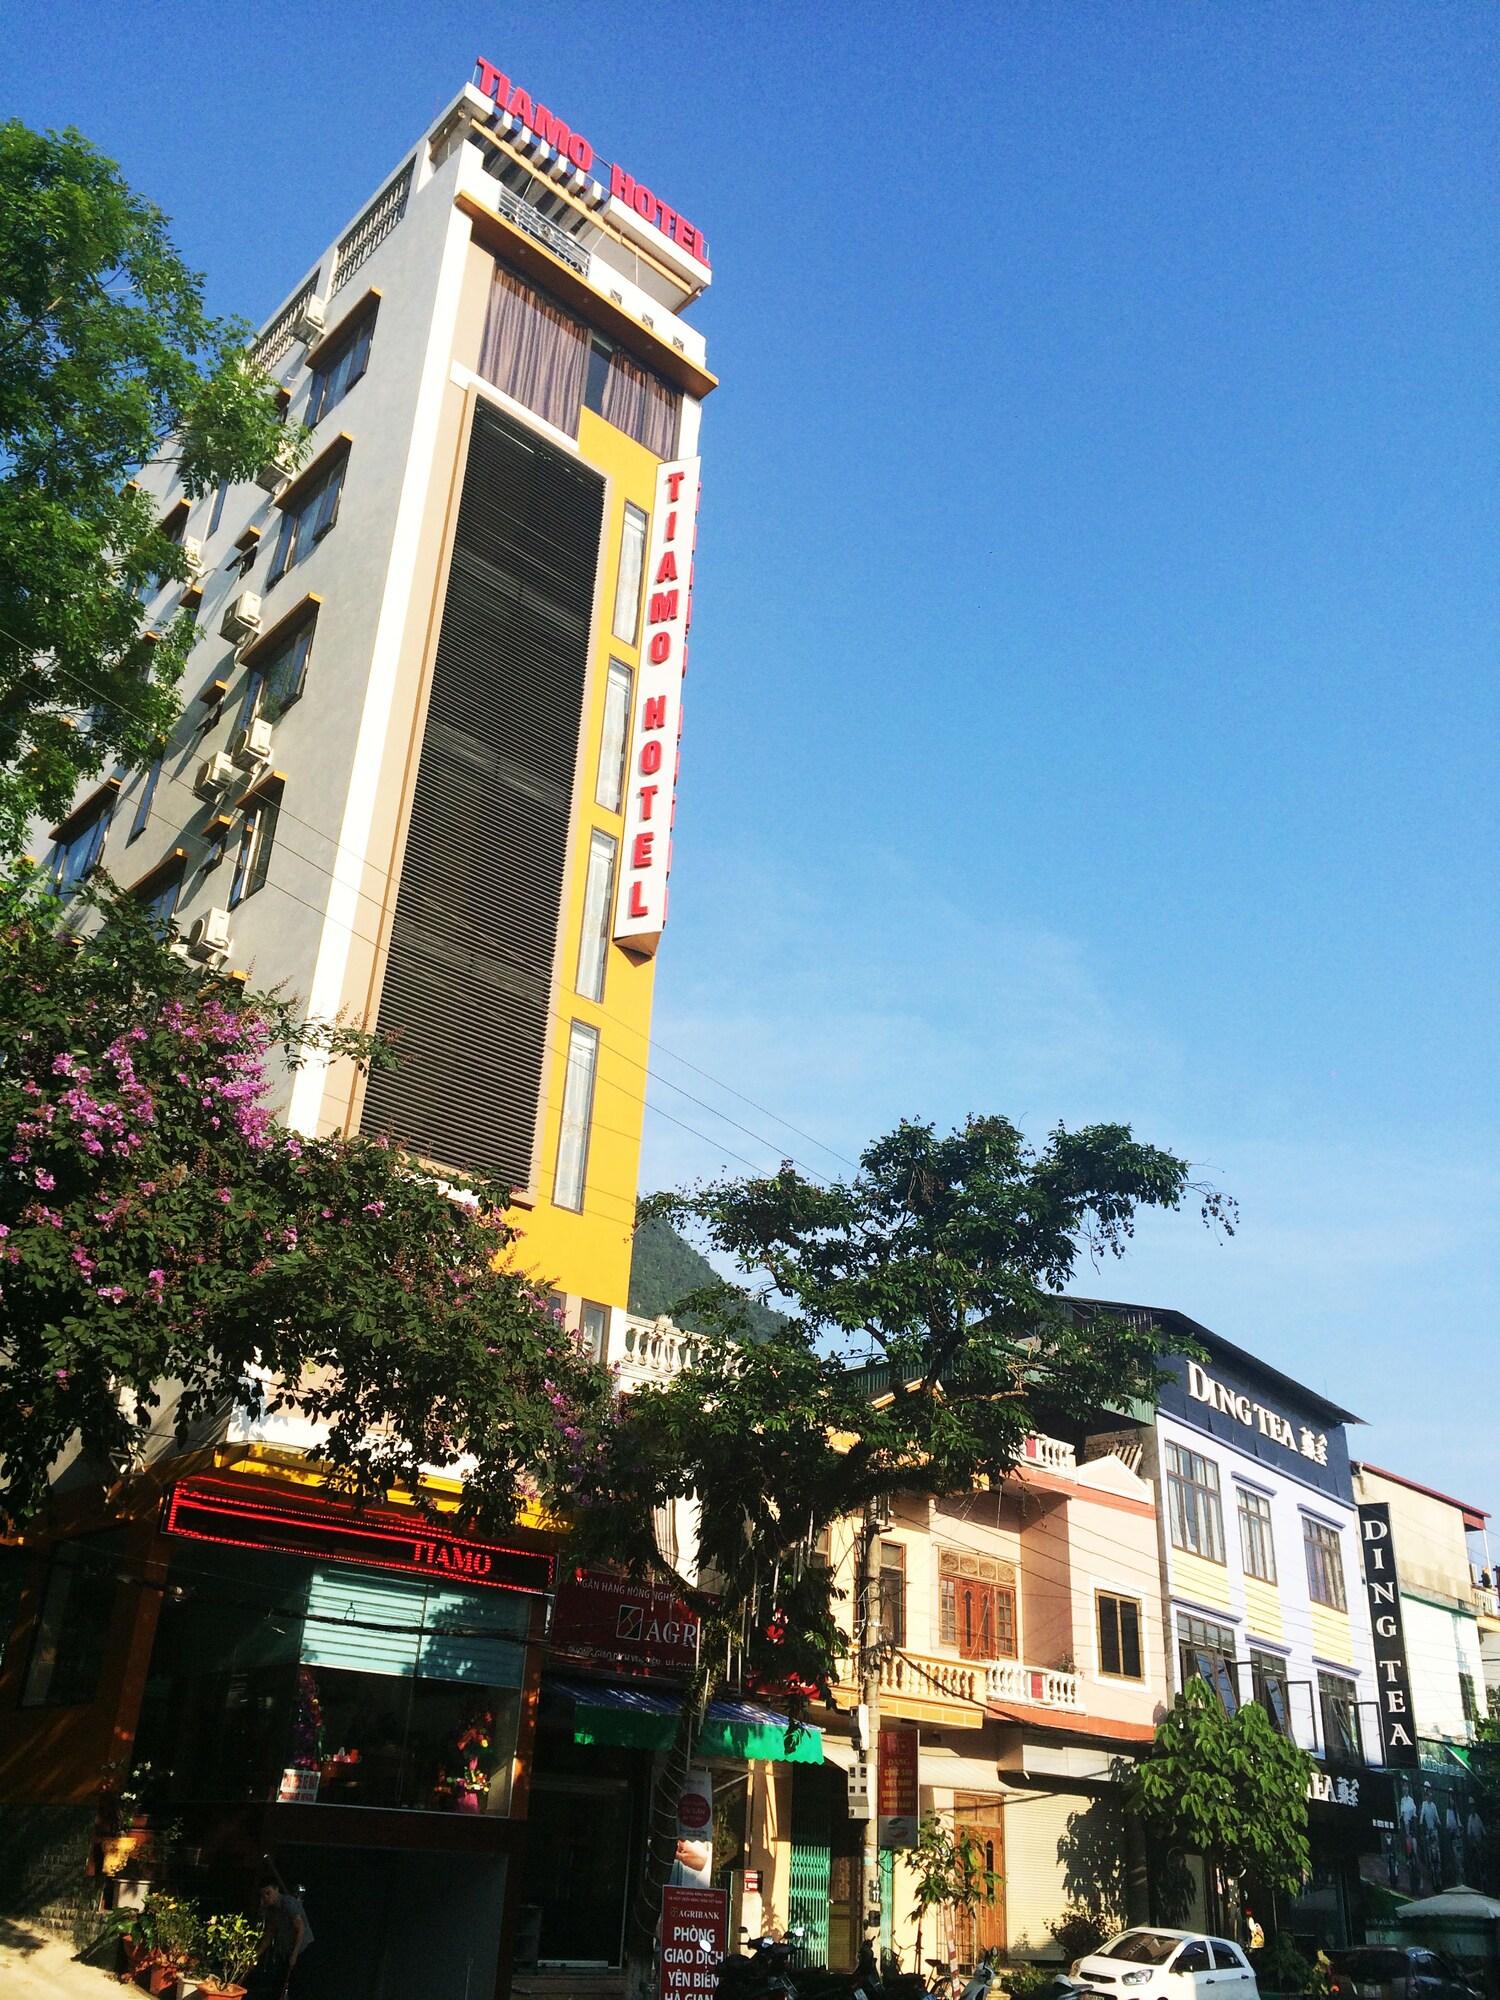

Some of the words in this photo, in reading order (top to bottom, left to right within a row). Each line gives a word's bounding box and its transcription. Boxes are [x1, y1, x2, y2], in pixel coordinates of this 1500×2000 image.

[476, 56, 594, 173] TIAMO
[611, 162, 711, 268] HOTEL
[649, 471, 685, 664] TIAMO
[629, 694, 667, 918] HOTEL
[1186, 1359, 1252, 1426] DING
[1253, 1402, 1299, 1453] TEA
[410, 1542, 492, 1576] TIAMO
[1363, 1519, 1397, 1638] DING
[1379, 1659, 1414, 1746] TEA
[664, 1948, 694, 1965] GIAO
[673, 1924, 716, 1944] PHÒNG
[679, 1909, 720, 1921] AGRIBANK
[668, 1968, 691, 1987] YÊN
